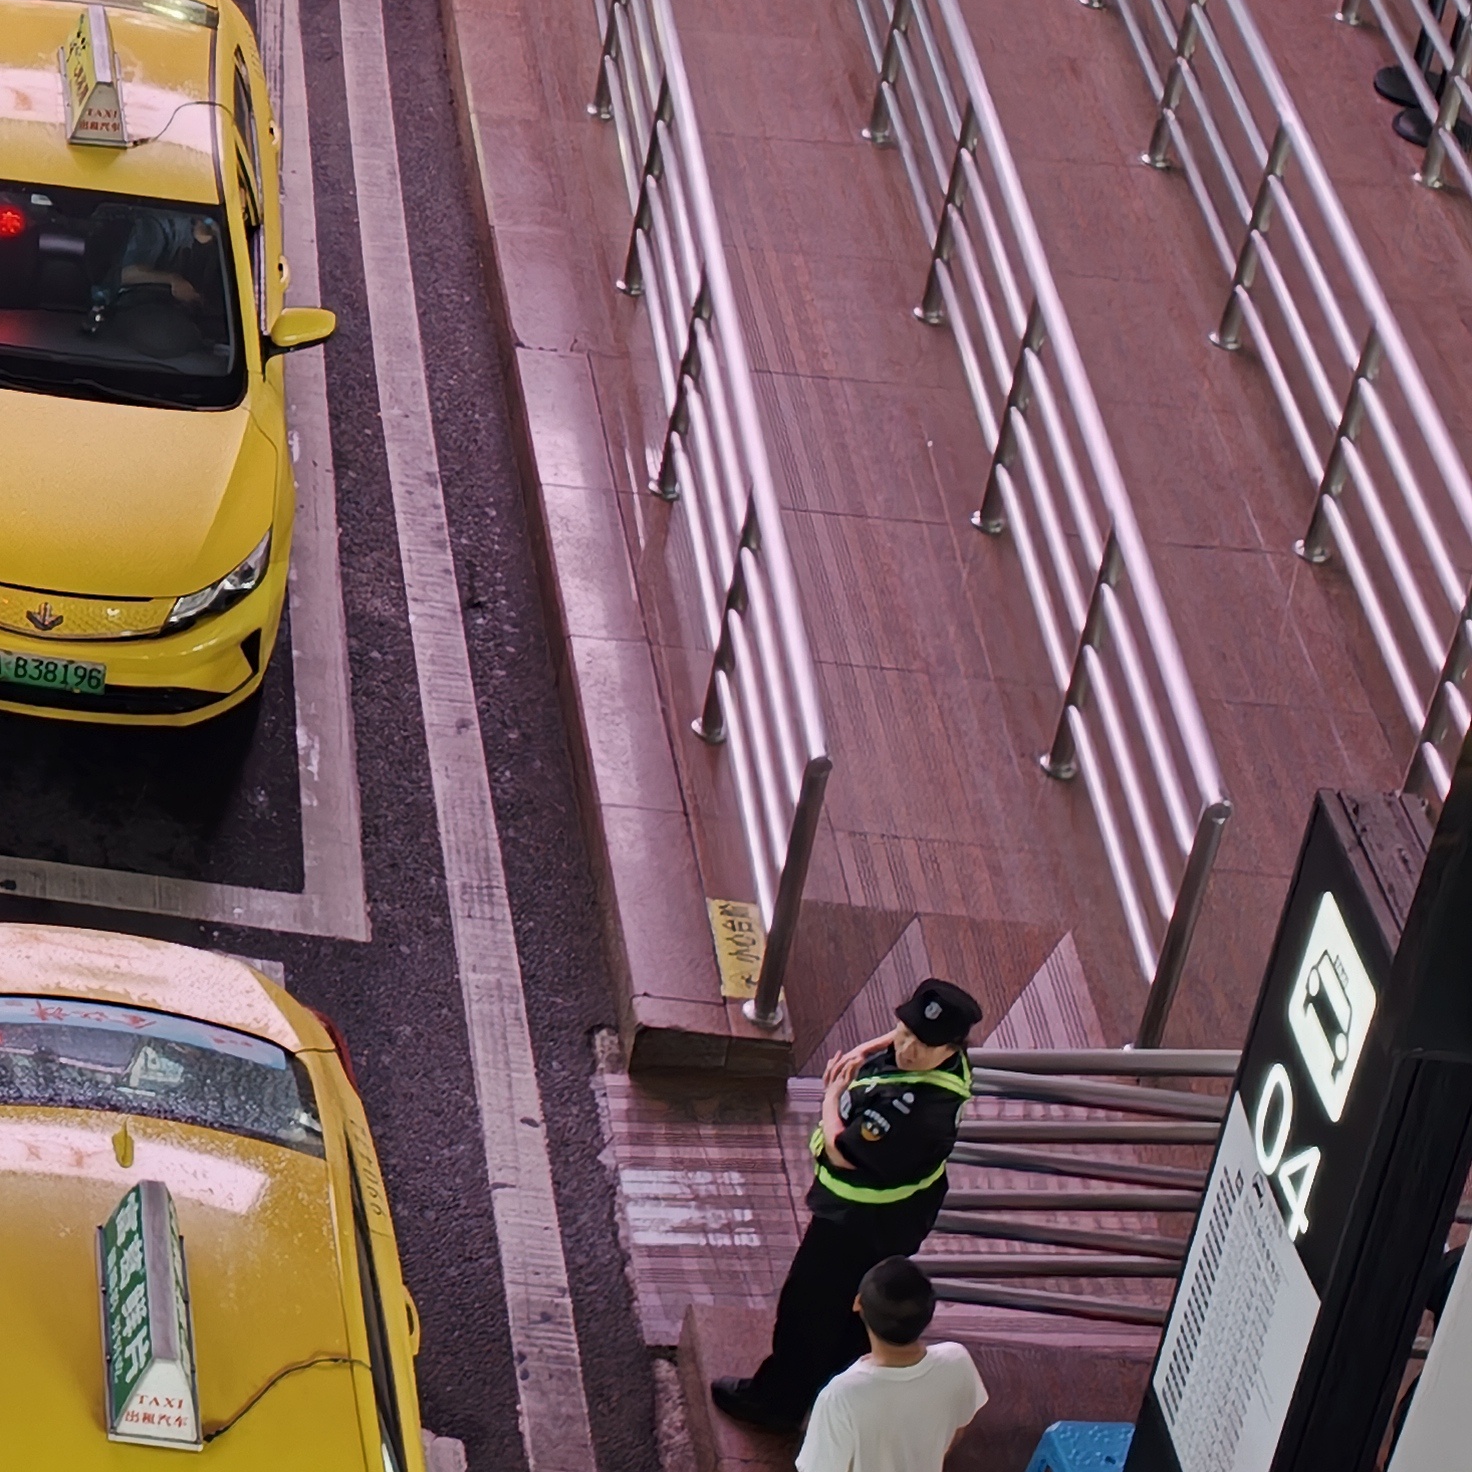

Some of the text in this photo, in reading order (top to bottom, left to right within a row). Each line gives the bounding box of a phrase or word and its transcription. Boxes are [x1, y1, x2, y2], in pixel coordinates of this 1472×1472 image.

[14, 657, 102, 689] B38196
[1255, 1062, 1323, 1242] 04
[138, 1395, 184, 1409] TAXI
[125, 1411, 188, 1428] 出租汽车
